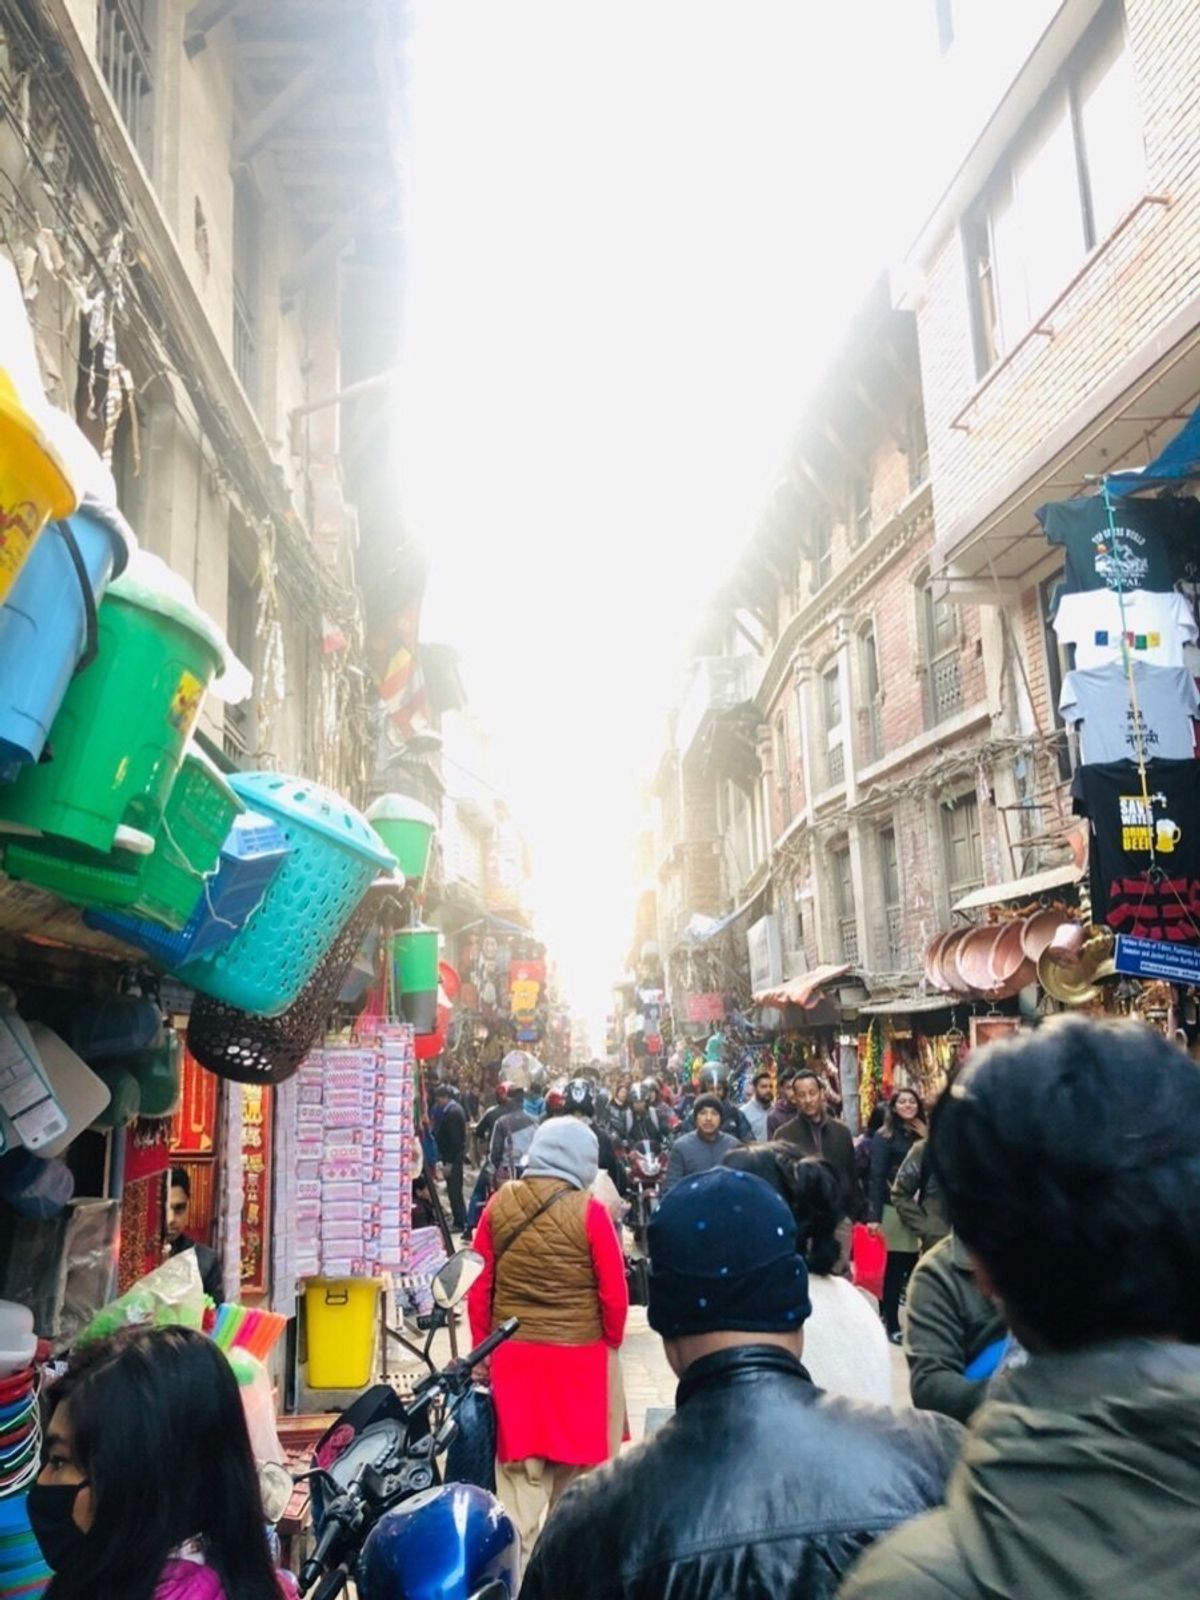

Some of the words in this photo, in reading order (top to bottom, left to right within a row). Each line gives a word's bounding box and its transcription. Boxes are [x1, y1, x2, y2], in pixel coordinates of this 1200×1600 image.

[1126, 528, 1146, 545] WORLD
[1106, 578, 1141, 587] NEPAL
[1119, 798, 1153, 815] SAVE
[1121, 813, 1154, 826] WATER
[1123, 836, 1152, 851] BEER
